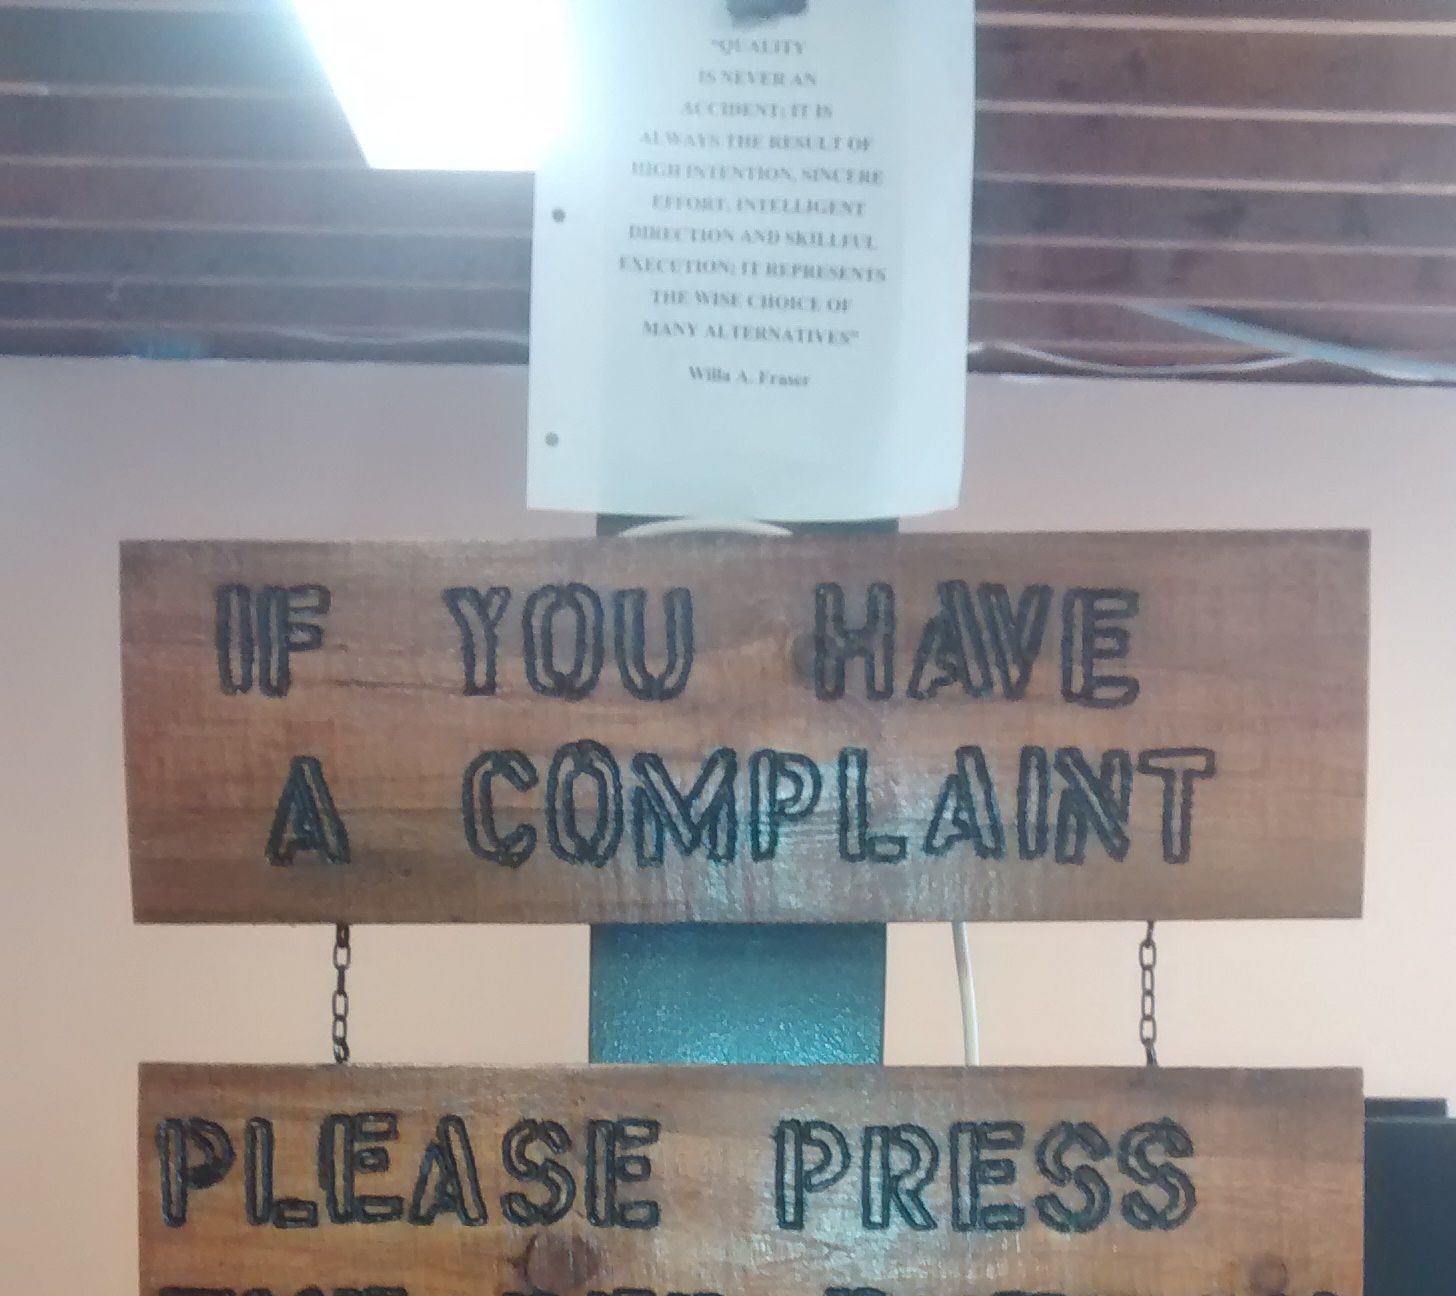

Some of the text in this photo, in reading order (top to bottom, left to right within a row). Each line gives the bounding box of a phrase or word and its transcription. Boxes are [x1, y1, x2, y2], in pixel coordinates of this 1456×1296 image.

[699, 69, 817, 87] IS NEVER AN
[791, 103, 809, 118] IT
[815, 103, 833, 119] IS
[639, 129, 873, 151] ALWAYS THE RESULT OF
[631, 161, 681, 178] HIGH
[802, 167, 884, 186] SINCERE
[736, 197, 867, 217] INTELLIGENT
[628, 225, 878, 251] DIRECTION AND SKILLFUL
[741, 260, 759, 277] IT
[765, 262, 888, 283] REPRESENTS
[651, 289, 852, 313] THE WISE CHOICE OF
[643, 320, 697, 338] MANY
[688, 365, 811, 387] Willa A. Fraser
[215, 579, 1141, 708] IF YOU HAVE
[264, 739, 1216, 868] A COMPLAINT
[155, 1112, 1198, 1234] PLEASE PRESS
